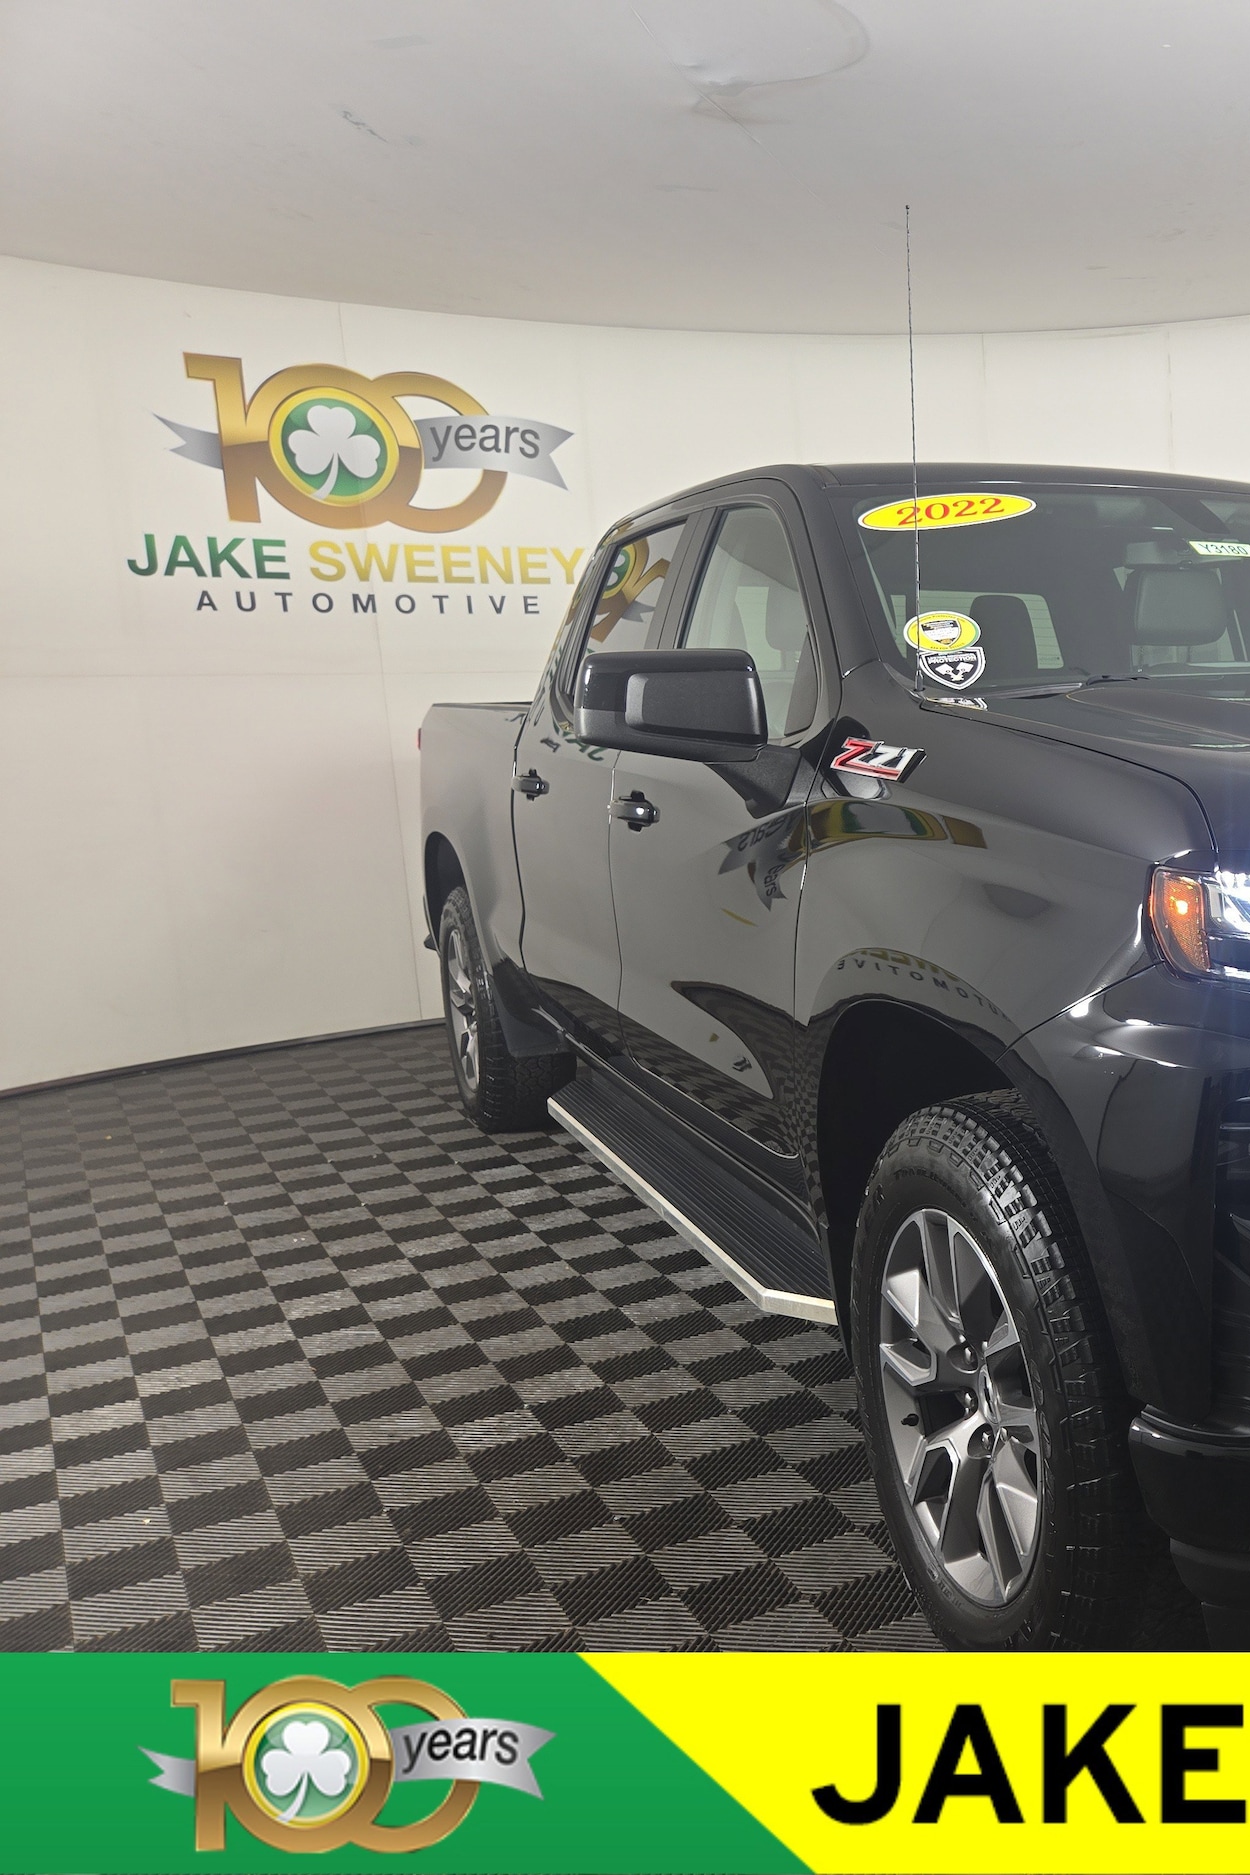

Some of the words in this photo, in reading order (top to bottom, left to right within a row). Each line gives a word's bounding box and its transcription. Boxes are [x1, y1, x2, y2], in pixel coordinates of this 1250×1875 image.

[429, 423, 540, 461] years
[896, 497, 1005, 526] 2022
[127, 534, 290, 579] JAKE
[309, 540, 585, 585] SWEENEY
[1198, 543, 1248, 555] Y3180
[196, 590, 540, 614] AUTOMOTIVE
[830, 736, 928, 783] Z71
